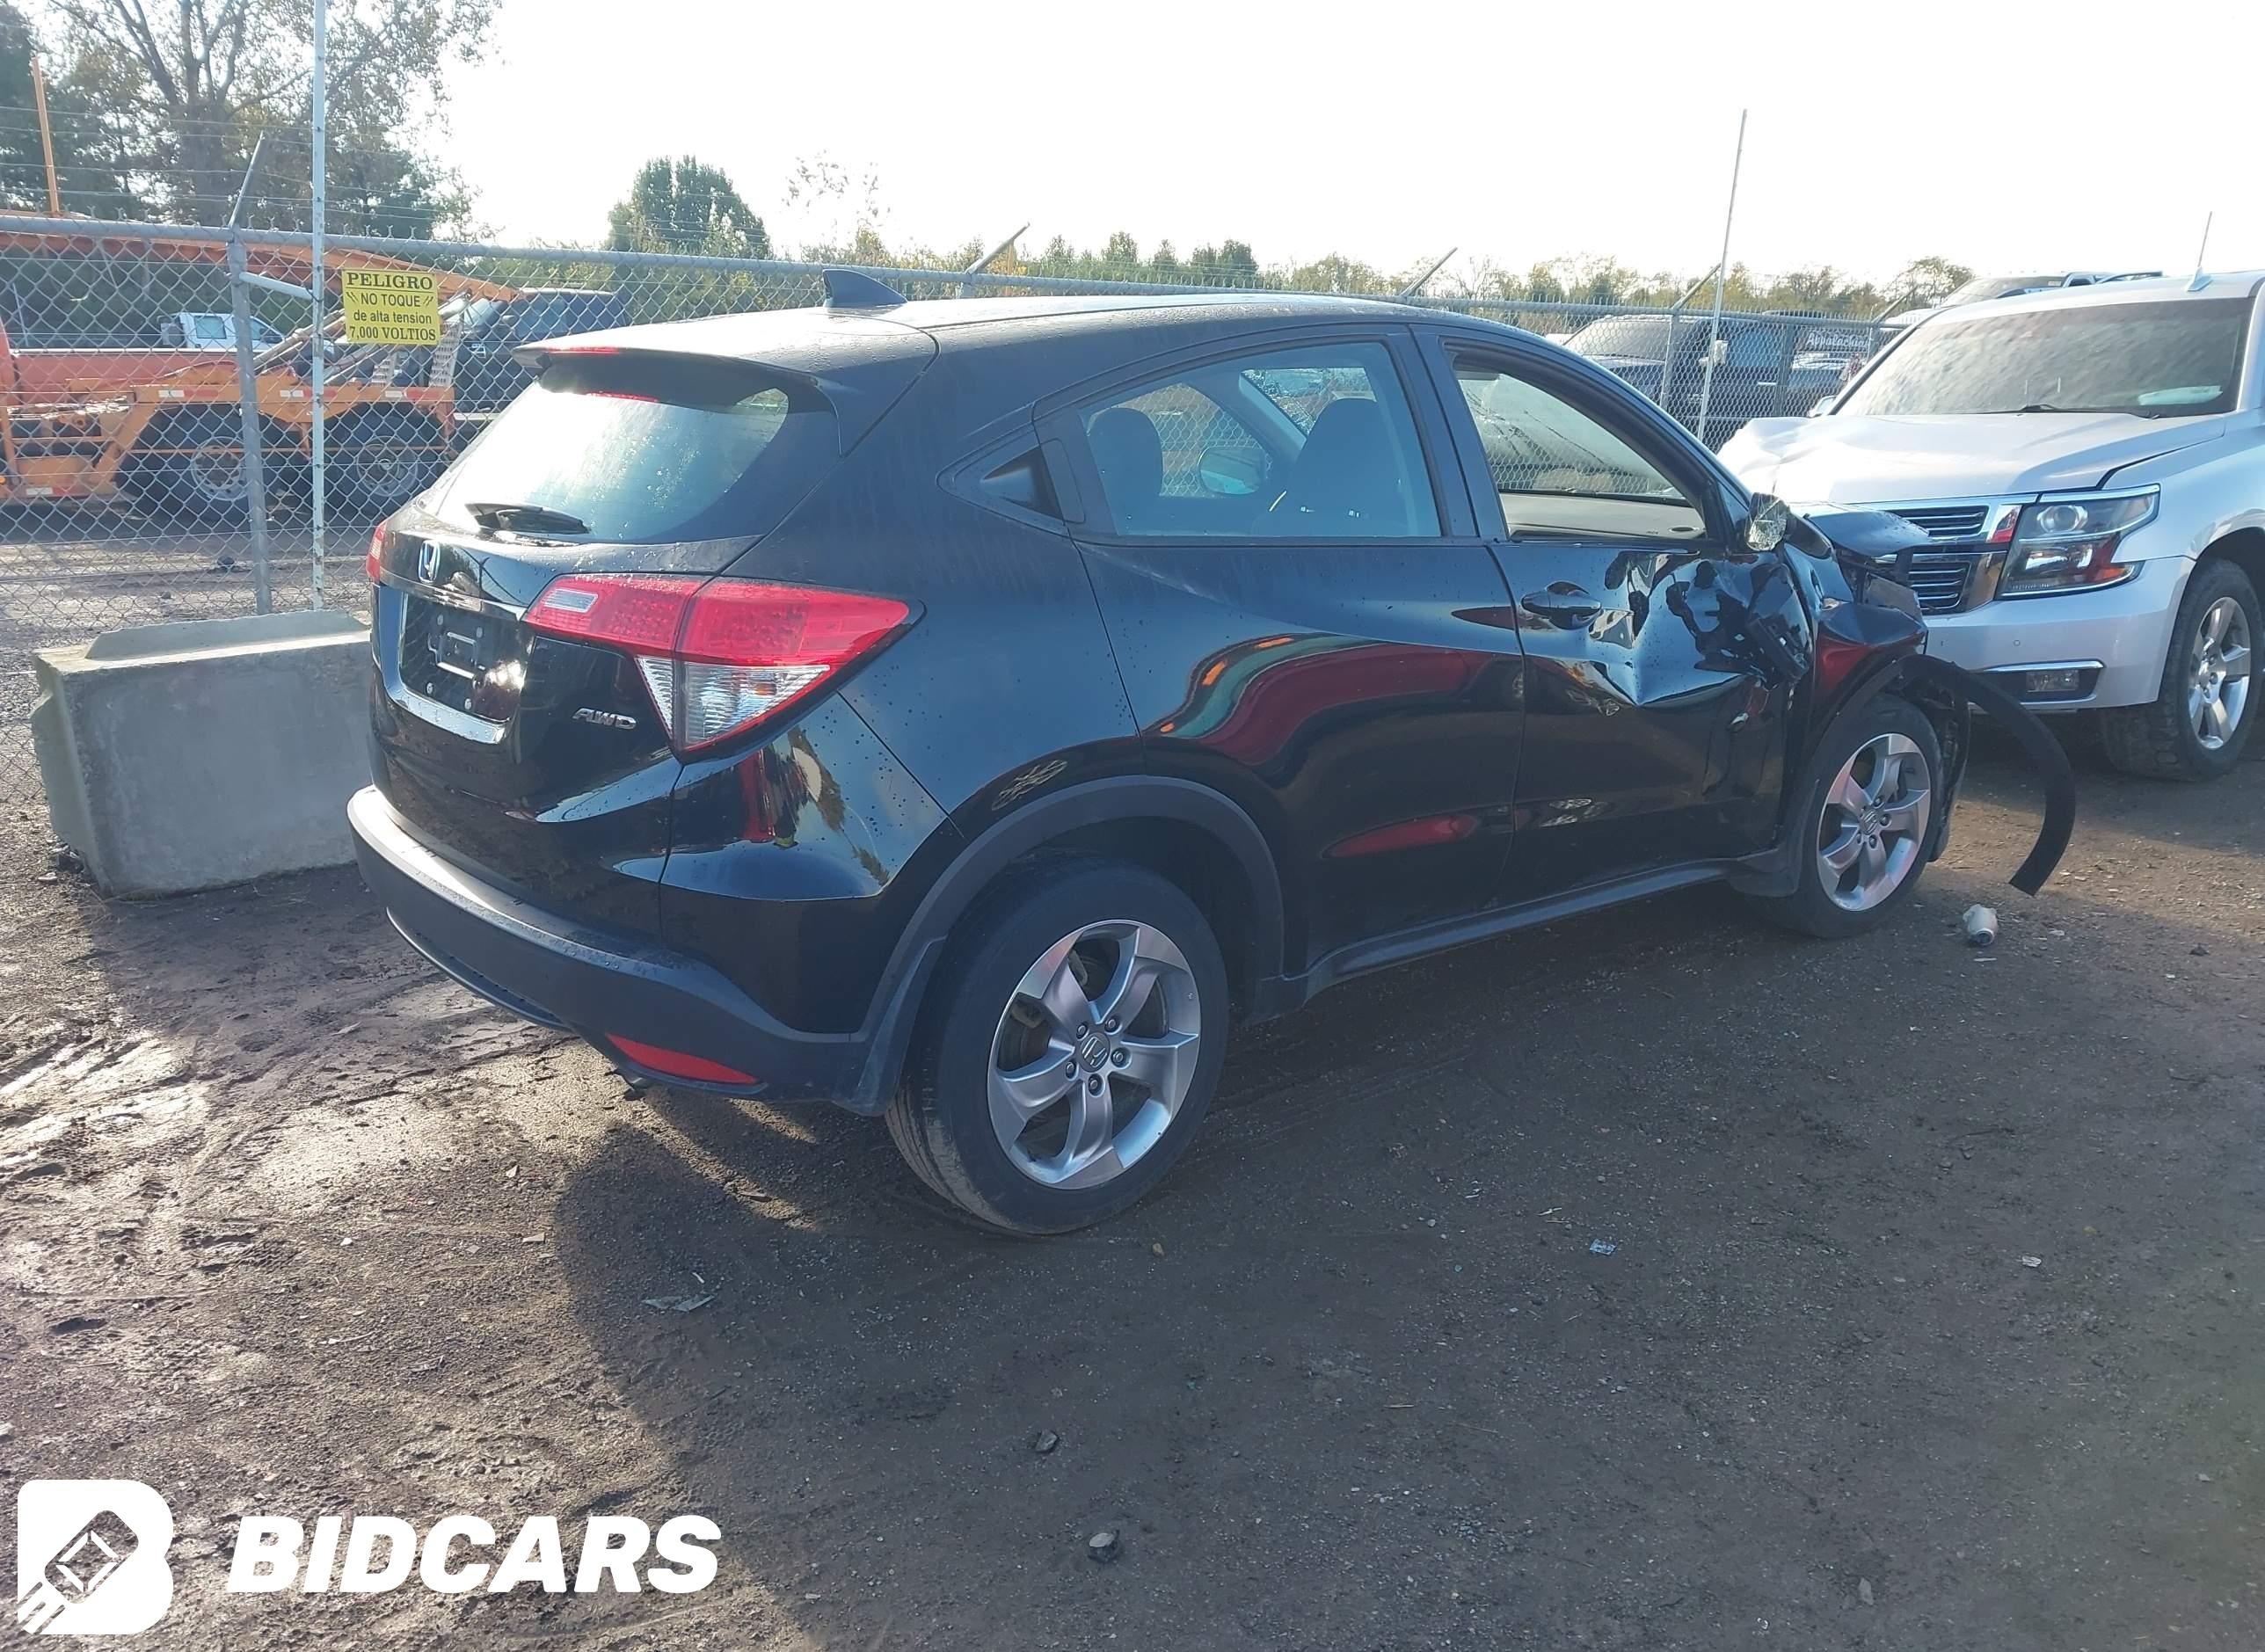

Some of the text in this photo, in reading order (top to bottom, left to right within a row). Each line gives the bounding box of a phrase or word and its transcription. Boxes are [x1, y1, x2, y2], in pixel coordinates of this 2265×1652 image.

[346, 272, 433, 290] PELIGRO
[361, 293, 421, 307] NO TOQUE
[353, 309, 432, 324] de alta tension
[349, 326, 436, 341] 7,000 VOLTIOS
[572, 708, 637, 730] AWD
